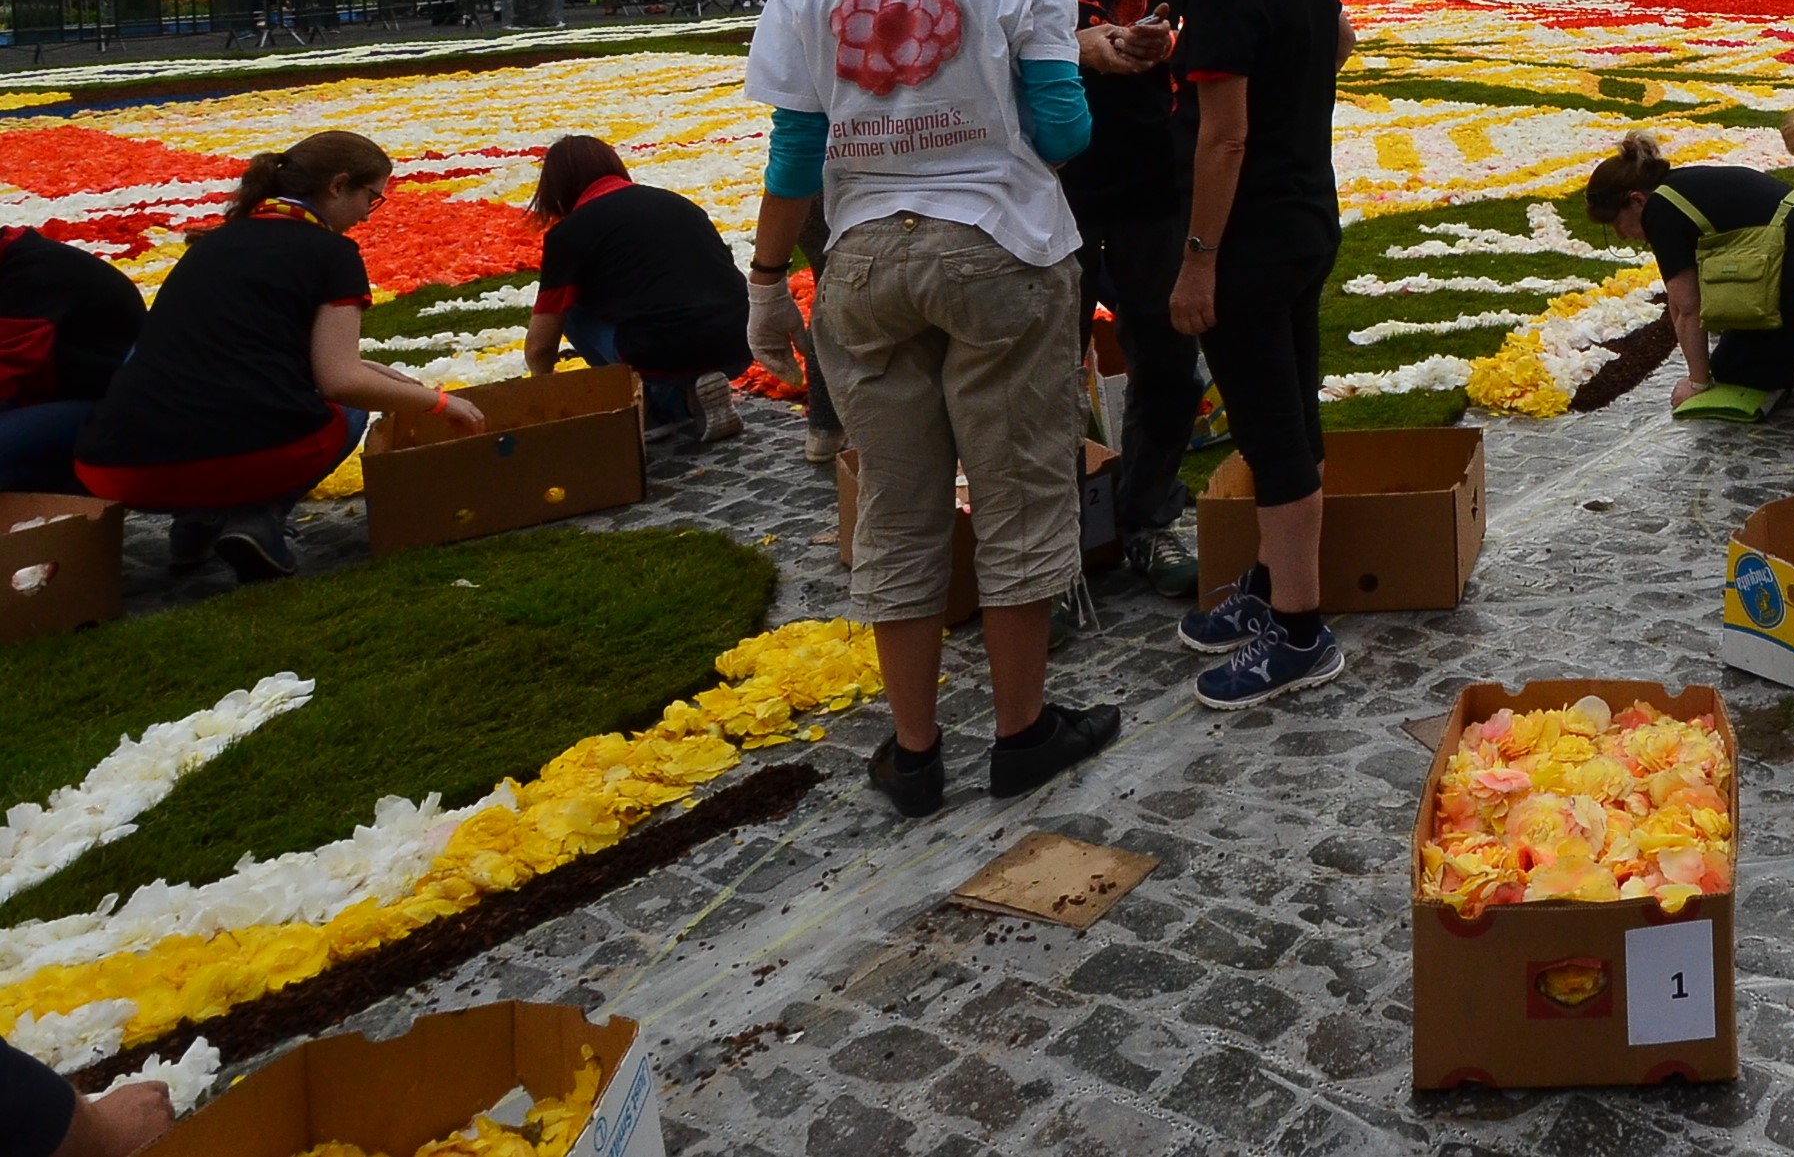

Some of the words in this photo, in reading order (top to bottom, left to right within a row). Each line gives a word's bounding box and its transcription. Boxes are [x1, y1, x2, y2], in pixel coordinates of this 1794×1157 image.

[890, 136, 915, 155] vol
[919, 127, 987, 150] bloemen
[1089, 488, 1099, 506] 2
[1736, 566, 1774, 591] Chiquita
[1670, 971, 1689, 1000] 1
